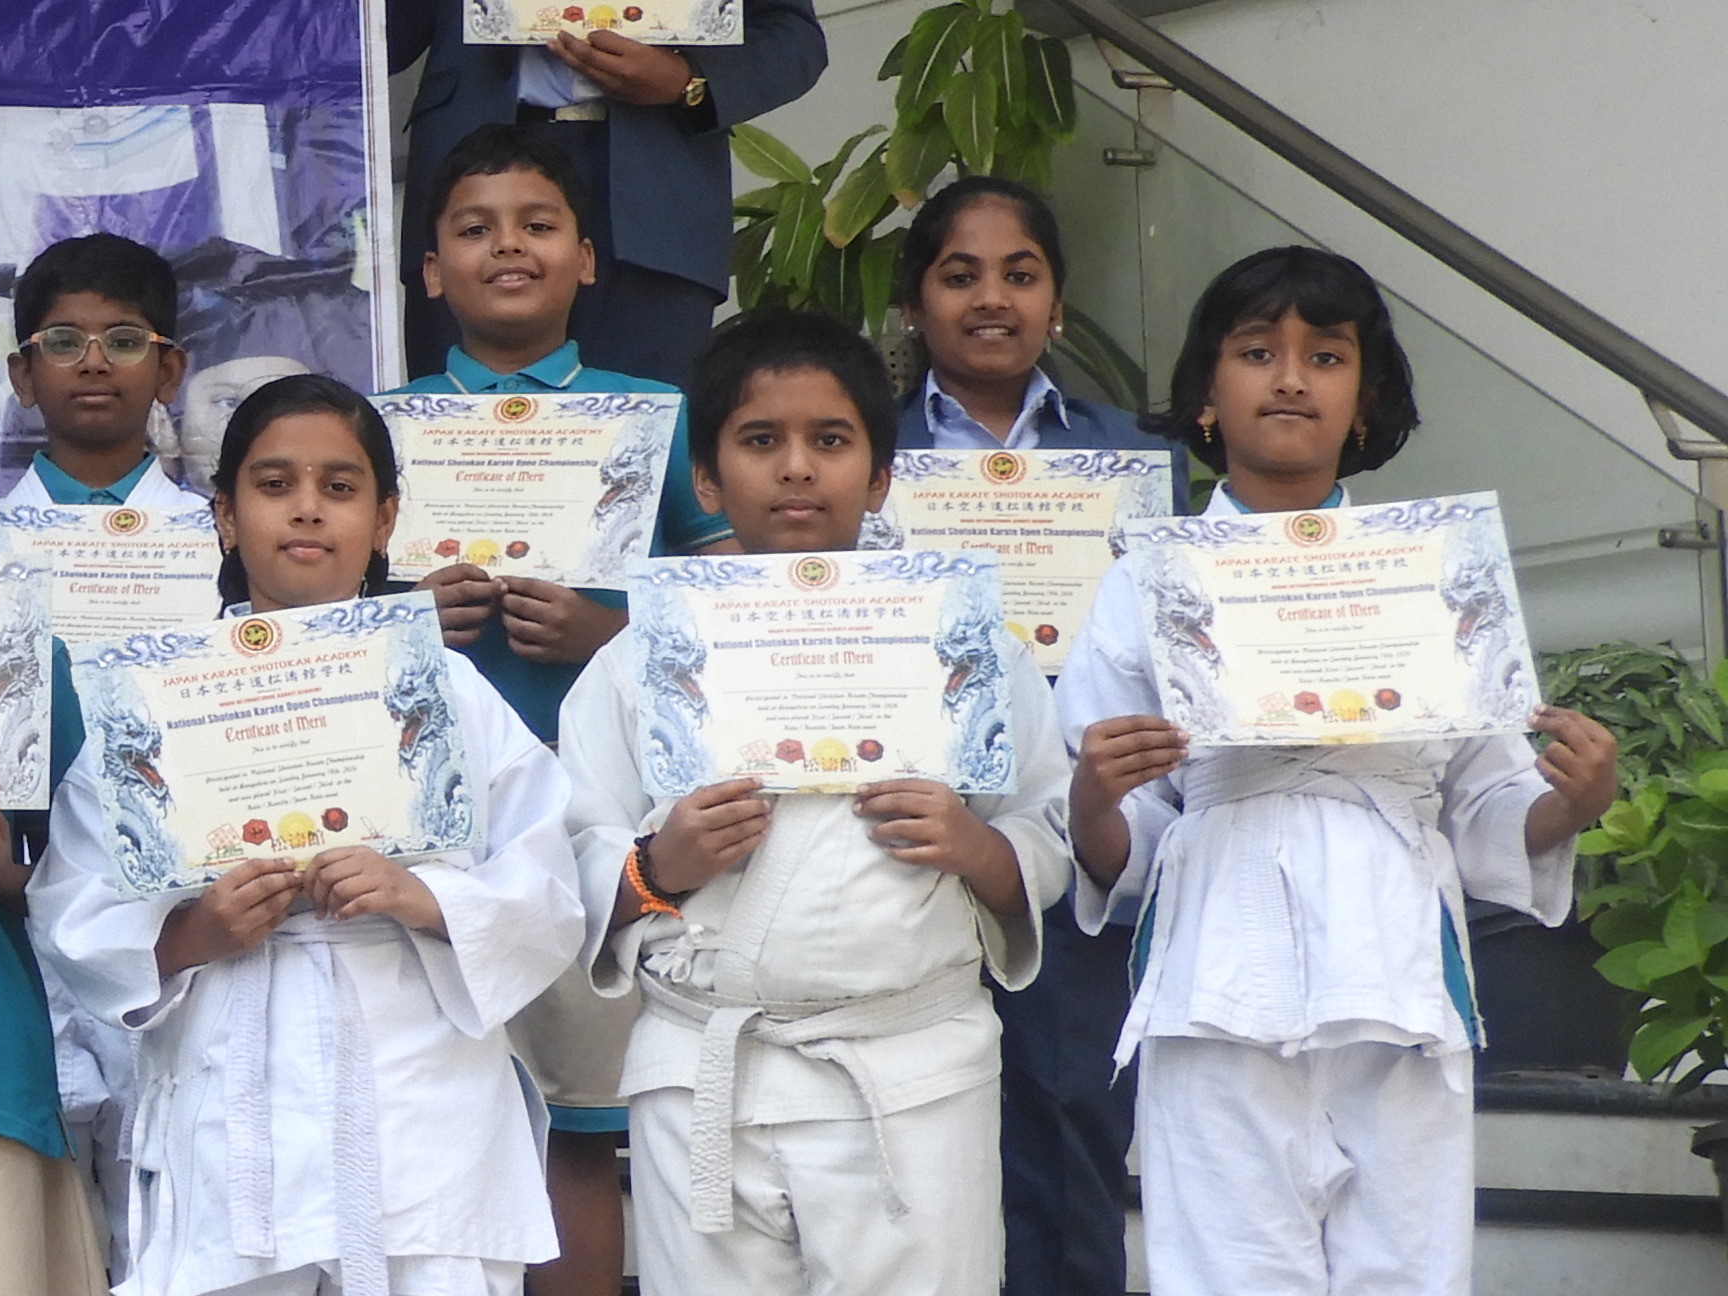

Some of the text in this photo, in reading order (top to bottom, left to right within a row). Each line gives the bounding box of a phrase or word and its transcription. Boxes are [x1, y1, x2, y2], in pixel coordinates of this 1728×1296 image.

[1214, 546, 1425, 568] JAPAN KARATE SHOTOKAN ACADEMY
[713, 595, 924, 610] JAPAN KARATE SHOTOKAN ACADEMY
[1276, 602, 1381, 622] Certificate of Merit
[713, 634, 930, 649] National Shotokan Karate Open Championship
[161, 648, 368, 688] JAPAN KARATE SHOTOKAN ACADEMY
[770, 650, 874, 667] Certificate of Merit
[166, 715, 206, 730] National
[207, 708, 252, 724] Shotokan
[253, 703, 285, 717] Karate
[285, 699, 310, 712] Open
[311, 689, 380, 709] Championship
[224, 712, 327, 743] Certificate of Merit
